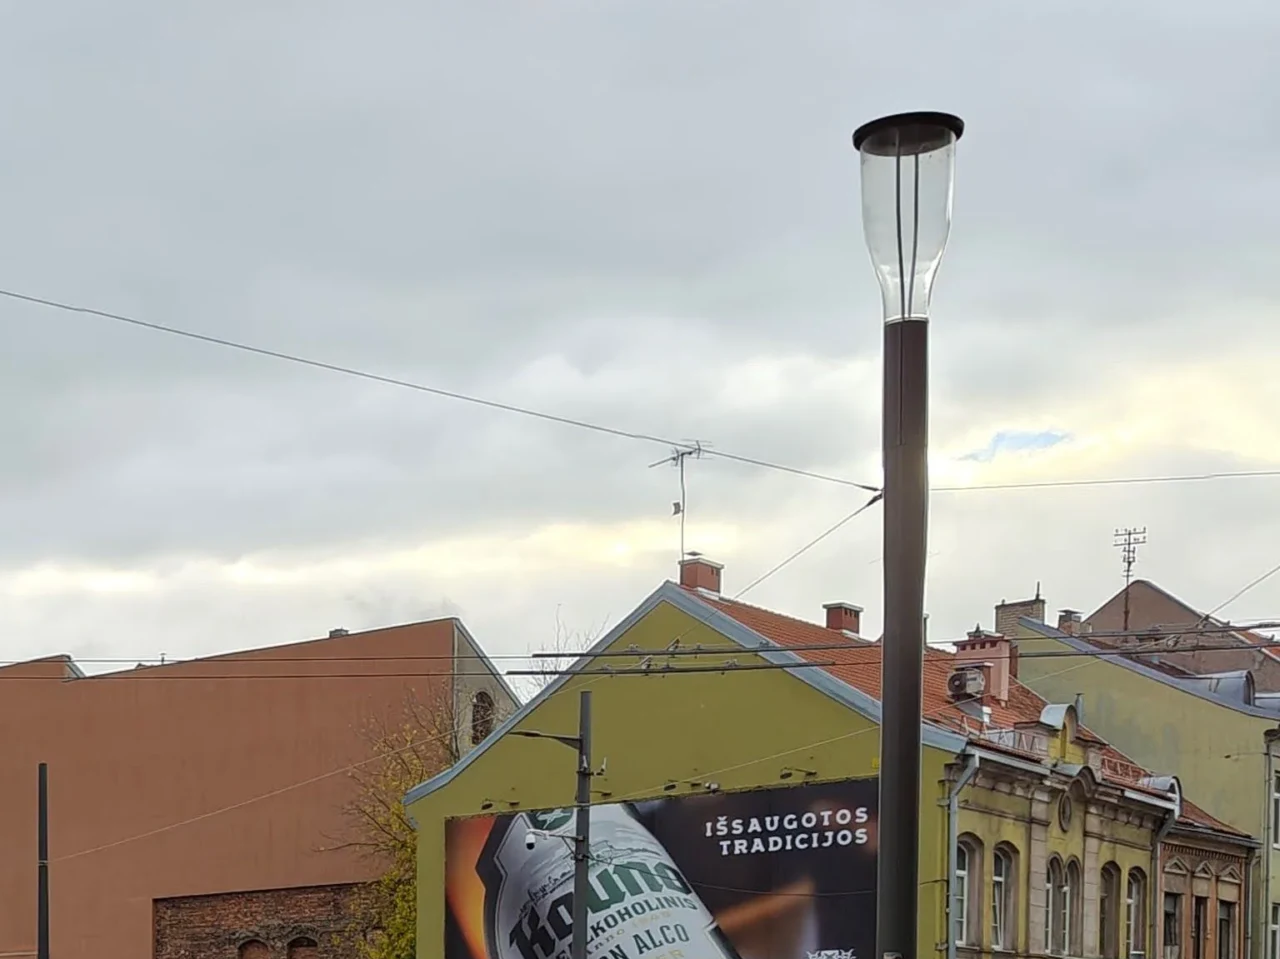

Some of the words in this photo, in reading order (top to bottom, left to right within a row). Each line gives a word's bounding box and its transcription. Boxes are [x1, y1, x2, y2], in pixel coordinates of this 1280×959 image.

[705, 807, 869, 837] IŠSAUGOTOS
[719, 828, 869, 856] TRADICIJOS
[632, 923, 690, 955] ALCO
